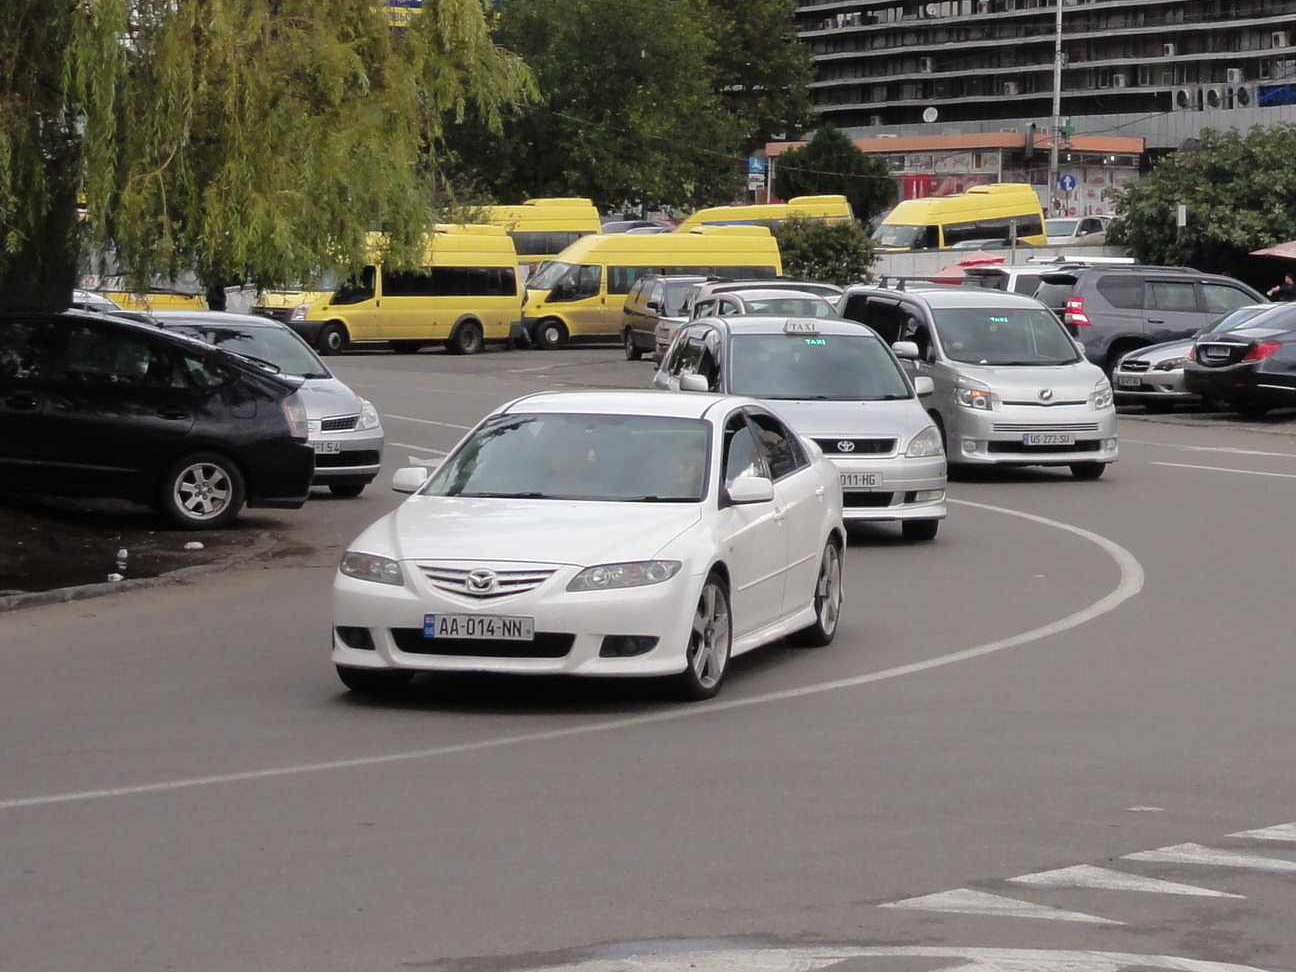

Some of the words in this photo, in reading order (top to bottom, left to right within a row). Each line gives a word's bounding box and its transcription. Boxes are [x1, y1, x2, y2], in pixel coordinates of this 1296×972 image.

[790, 323, 816, 332] TAXI
[805, 338, 826, 346] TAXI
[439, 618, 522, 637] AA-014-NN
